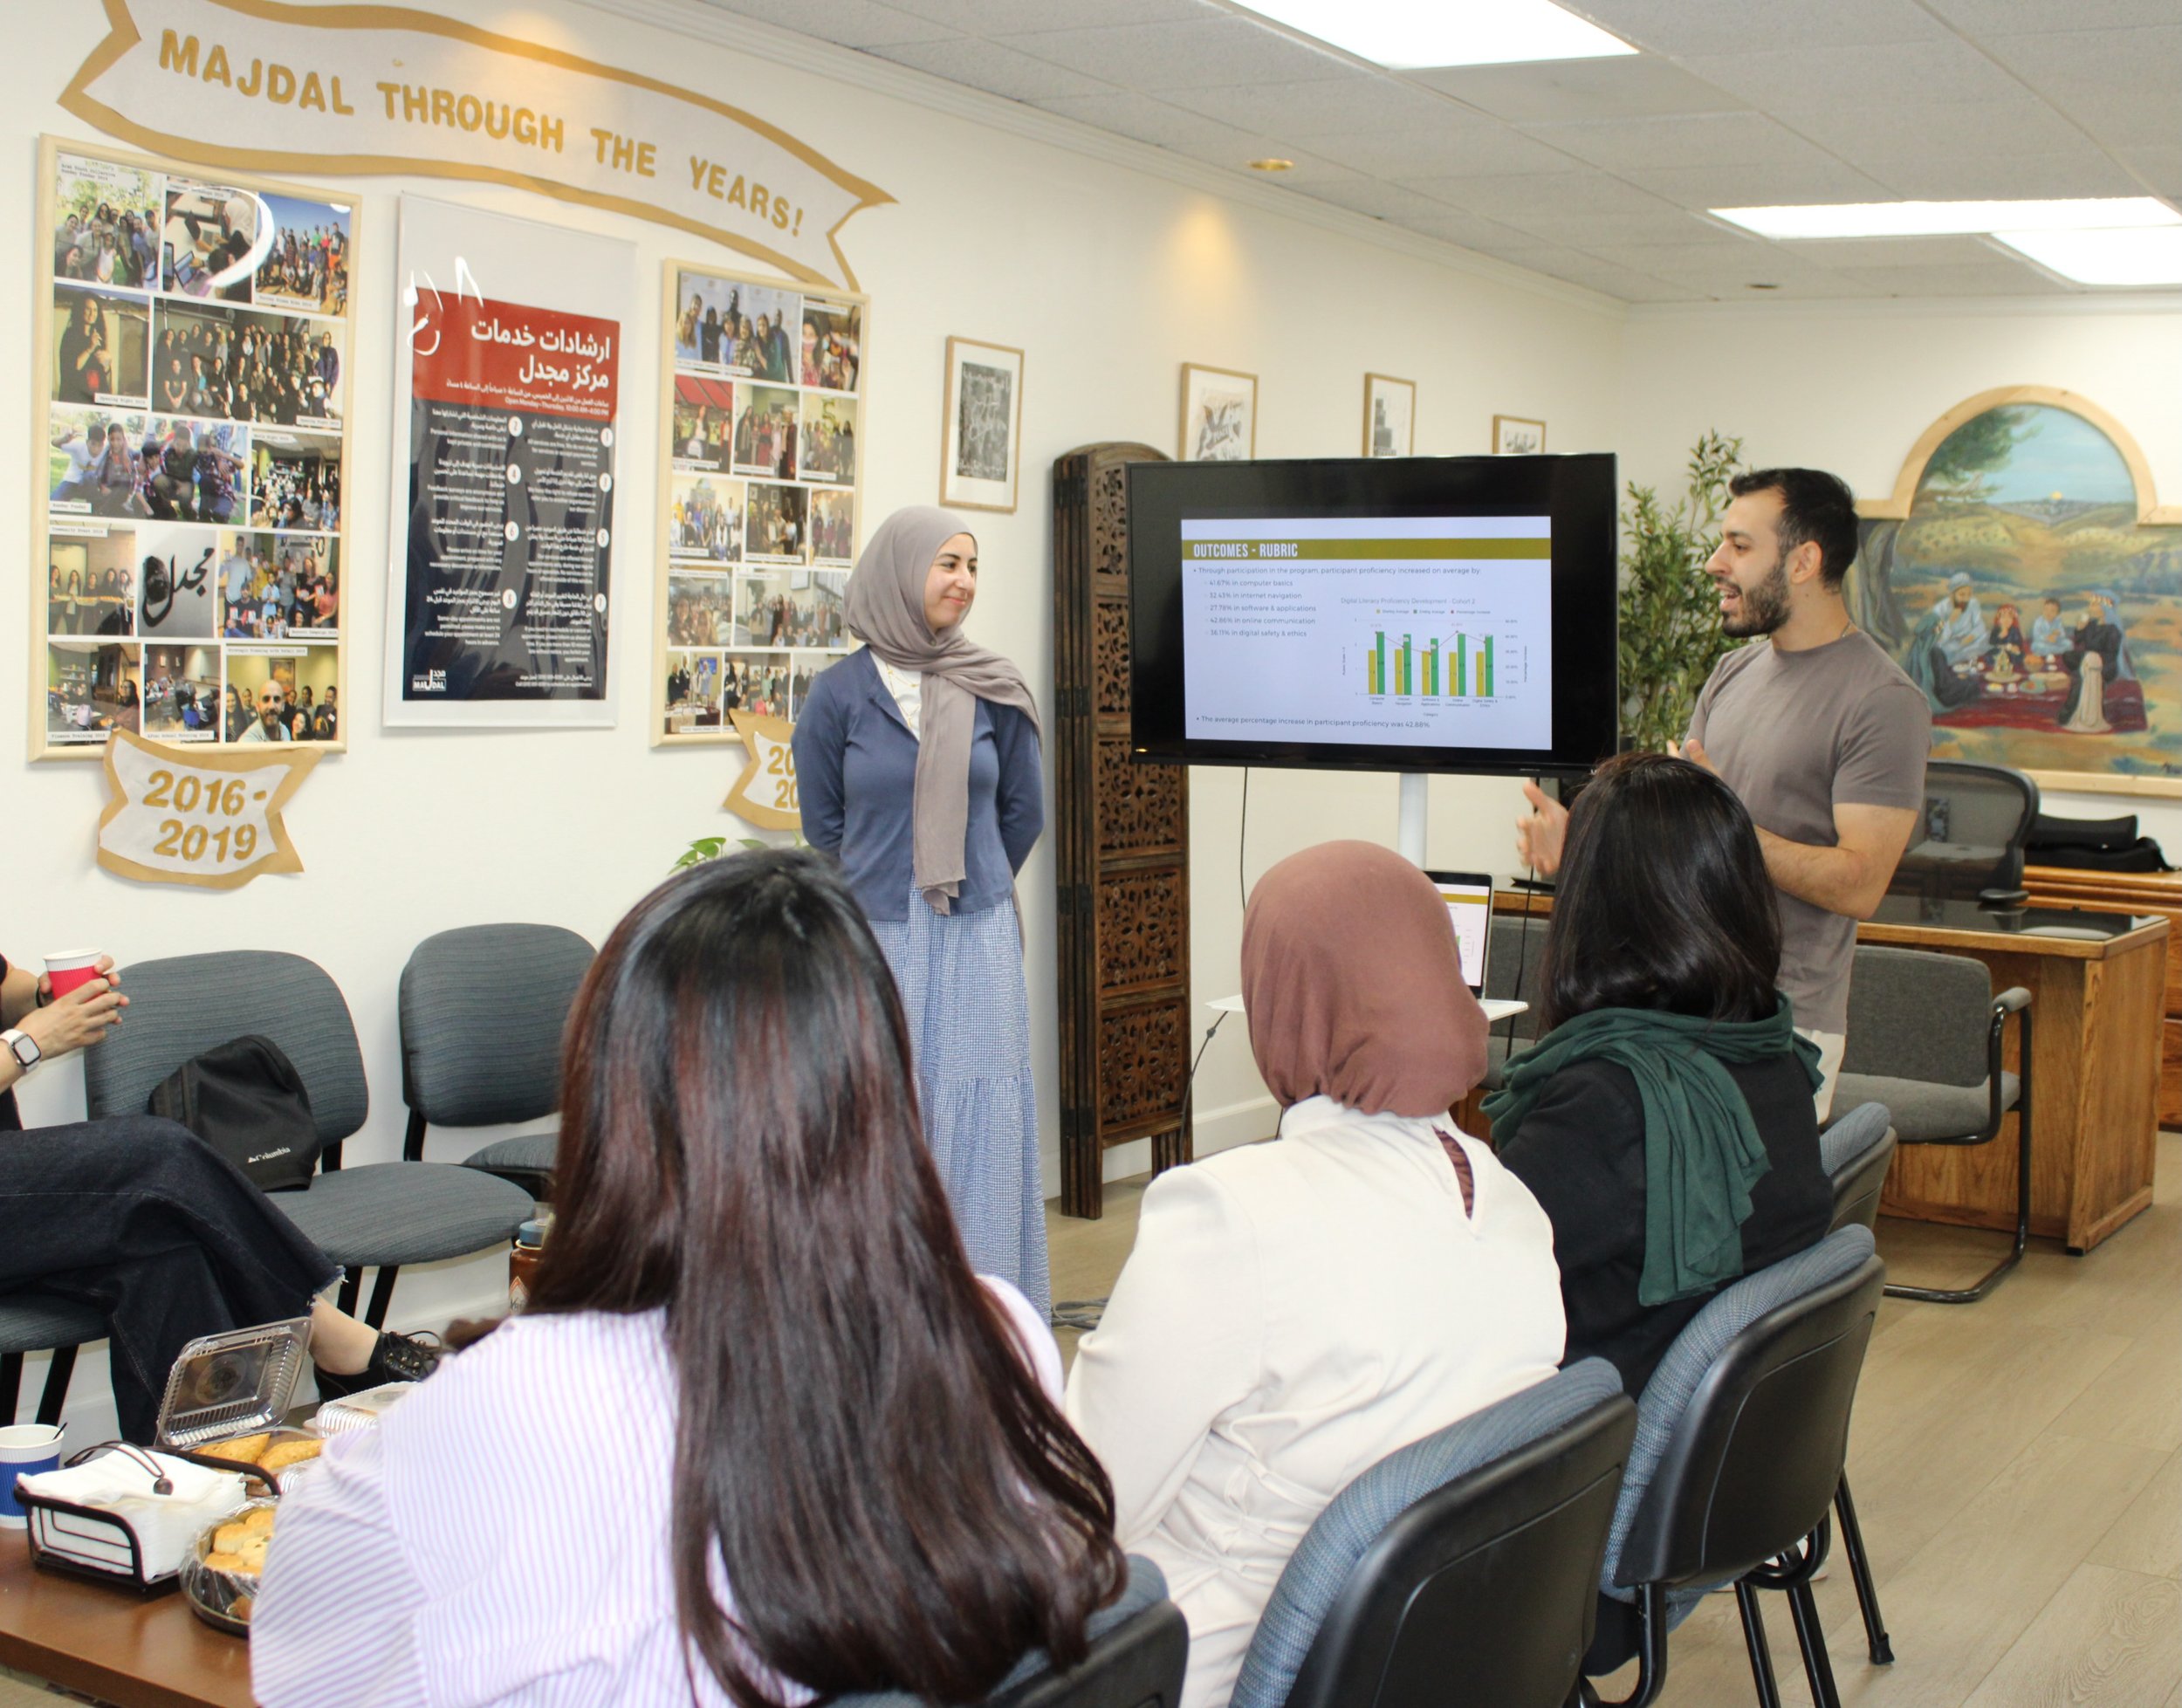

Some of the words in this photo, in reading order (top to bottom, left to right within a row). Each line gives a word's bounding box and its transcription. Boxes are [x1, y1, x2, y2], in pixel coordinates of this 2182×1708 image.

[158, 28, 354, 116] MAJDAL
[376, 81, 564, 154] THROUGH
[590, 127, 656, 177] THE
[690, 155, 804, 237] YEARS!
[470, 318, 536, 347] خدمات
[539, 329, 611, 363] ارشادات
[518, 354, 570, 387] مجدل
[572, 363, 610, 392] مركز
[1193, 543, 1249, 558] OUTCOMES
[1259, 543, 1299, 558] RUBRIC
[1321, 567, 1358, 576] participant
[1359, 567, 1396, 576] proficiency
[1353, 719, 1389, 728] proficiency
[153, 819, 257, 863] 2019
[255, 1147, 292, 1161] Columbia
